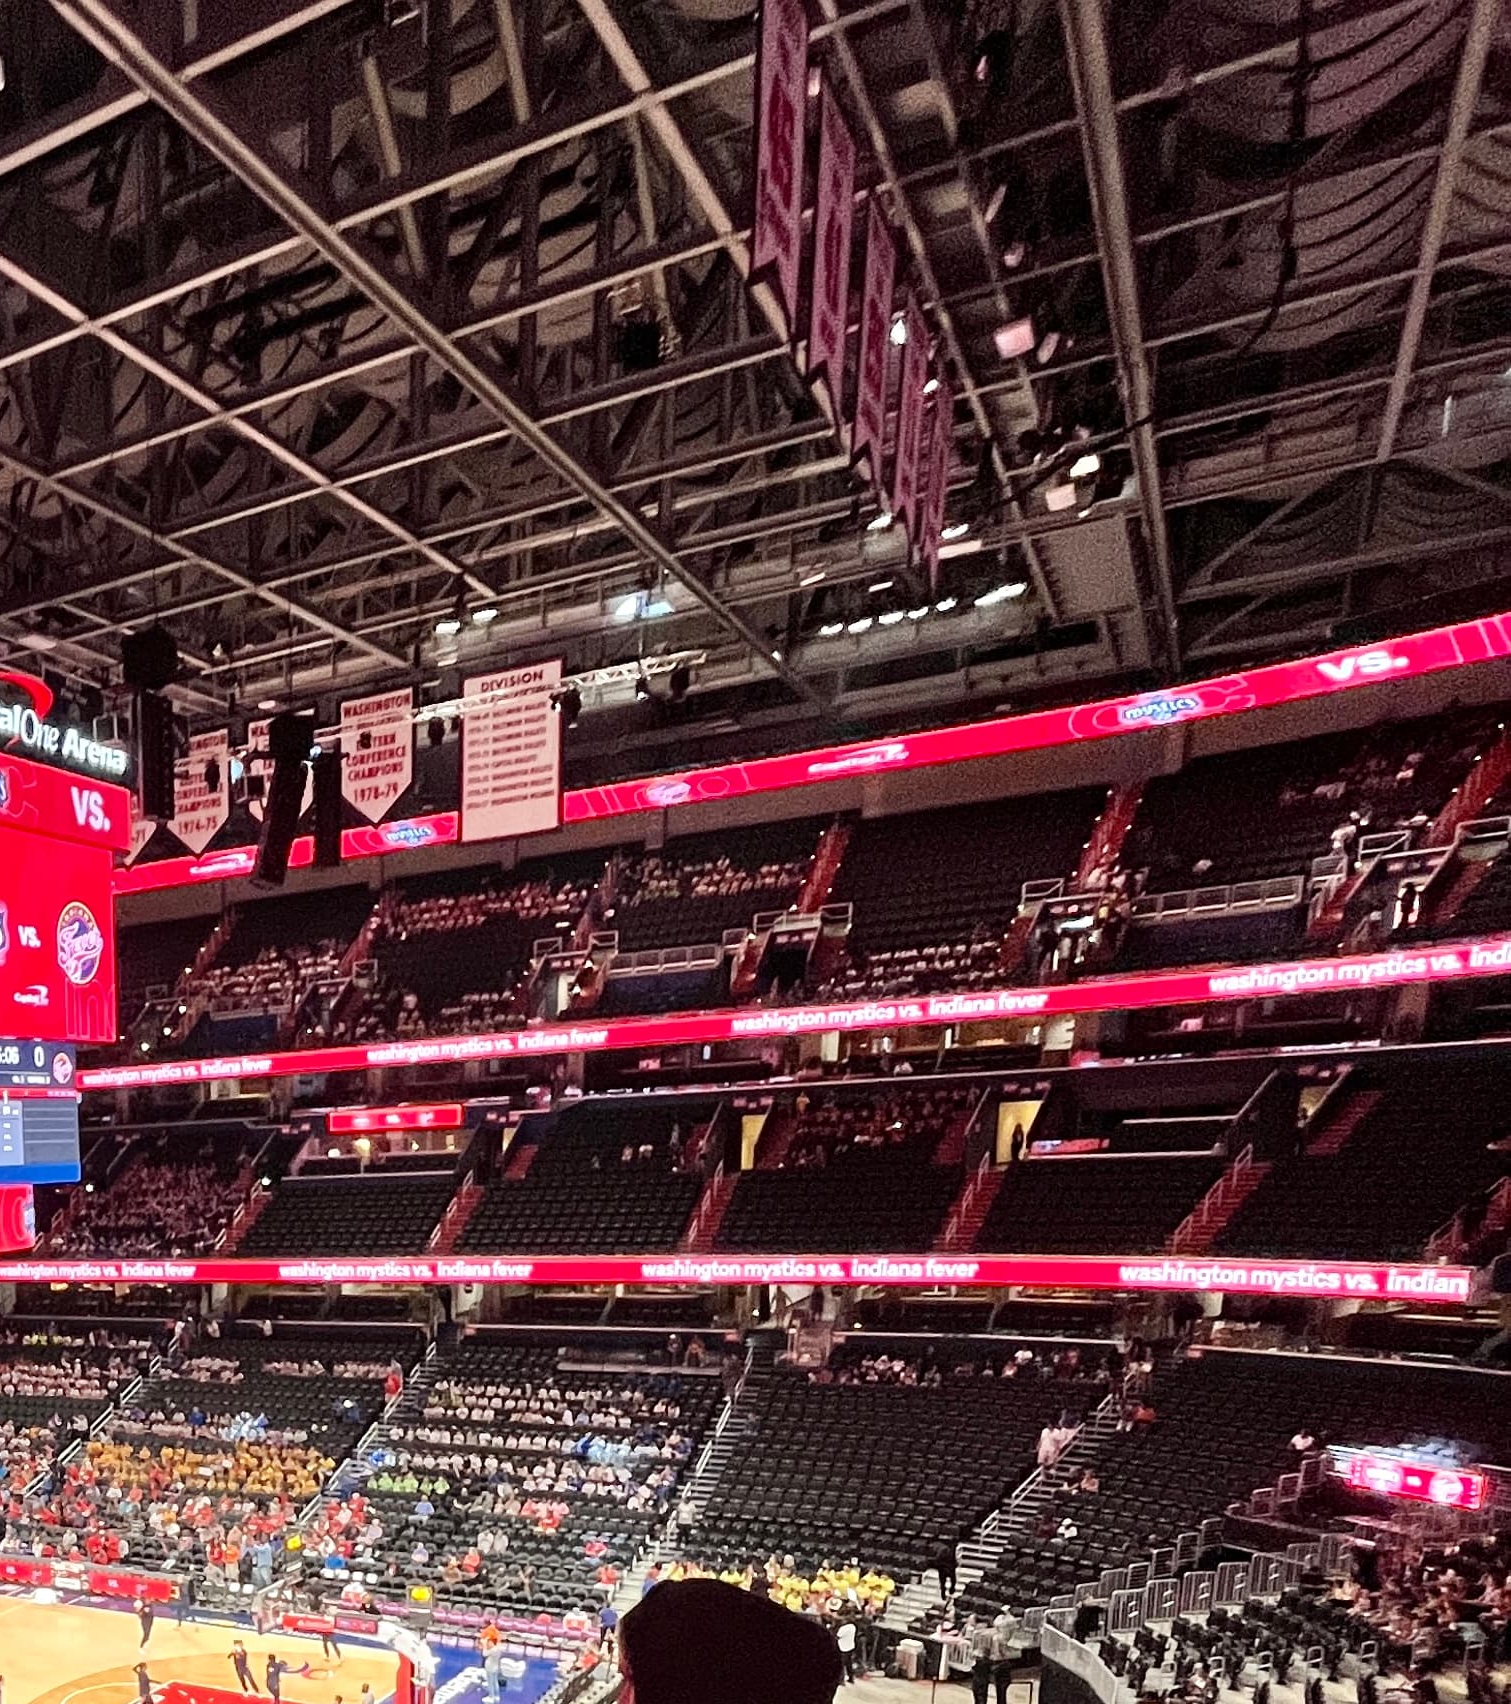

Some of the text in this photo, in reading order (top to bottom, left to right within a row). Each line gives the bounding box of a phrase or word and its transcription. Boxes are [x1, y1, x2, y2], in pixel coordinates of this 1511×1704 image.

[481, 670, 544, 693] DIVISION
[344, 693, 411, 719] WASHINGTON
[62, 728, 129, 776] Arena
[346, 746, 407, 767] CONFERENCE
[348, 762, 404, 782] CHAMPIONS
[1209, 965, 1333, 993] washington
[1337, 955, 1426, 983] mystics
[1430, 955, 1460, 972] vs.
[732, 1009, 826, 1034] washington
[828, 1002, 895, 1026] mystics
[899, 1004, 922, 1018] vs.
[998, 990, 1048, 1010] fever
[34, 1046, 45, 1067] 0
[367, 1045, 439, 1063] washington
[441, 1038, 493, 1059] mystics
[495, 1039, 514, 1050] vs.
[570, 1029, 609, 1045] fever
[83, 1069, 140, 1085] washington
[142, 1066, 182, 1082] mystics
[242, 1057, 272, 1073] fever
[59, 1263, 101, 1280] mystics
[165, 1262, 197, 1277] fever
[279, 1262, 354, 1281] washington
[356, 1262, 410, 1281] mystics
[413, 1265, 433, 1278] vs.
[492, 1260, 533, 1278] fever
[642, 1260, 740, 1281] washington
[744, 1261, 815, 1281] mystics
[819, 1263, 845, 1278] vs.
[925, 1259, 979, 1278] fever
[1119, 1261, 1246, 1290] washington
[1251, 1265, 1340, 1292] mystics
[1345, 1272, 1378, 1290] vs.
